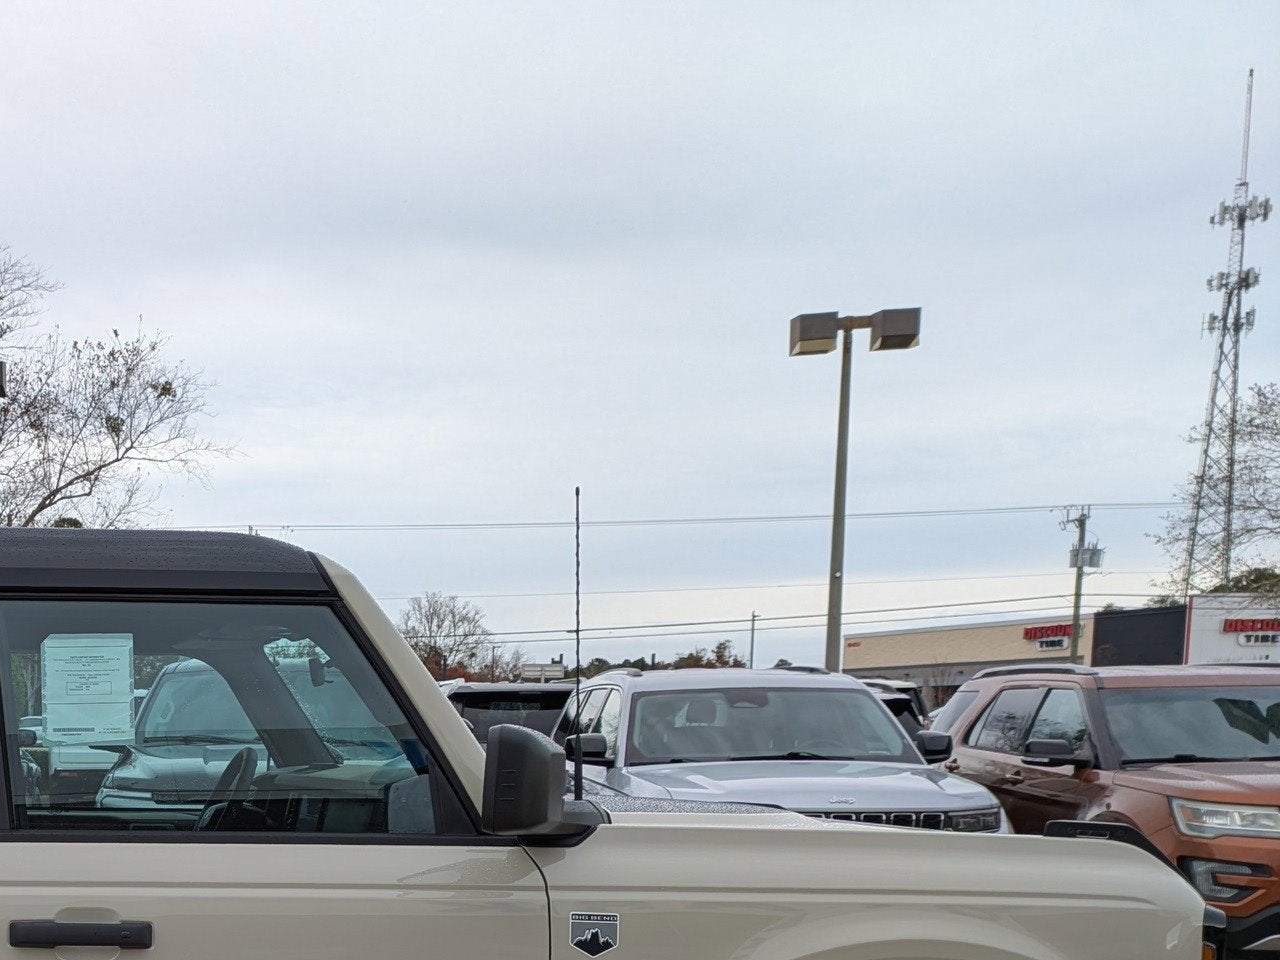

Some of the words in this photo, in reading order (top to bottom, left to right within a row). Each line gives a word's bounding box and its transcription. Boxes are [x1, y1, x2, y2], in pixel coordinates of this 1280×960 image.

[1023, 624, 1074, 640] DISCOUN
[1244, 634, 1280, 643] TIRE
[1038, 639, 1064, 648] TIRE
[830, 796, 856, 806] Jeep
